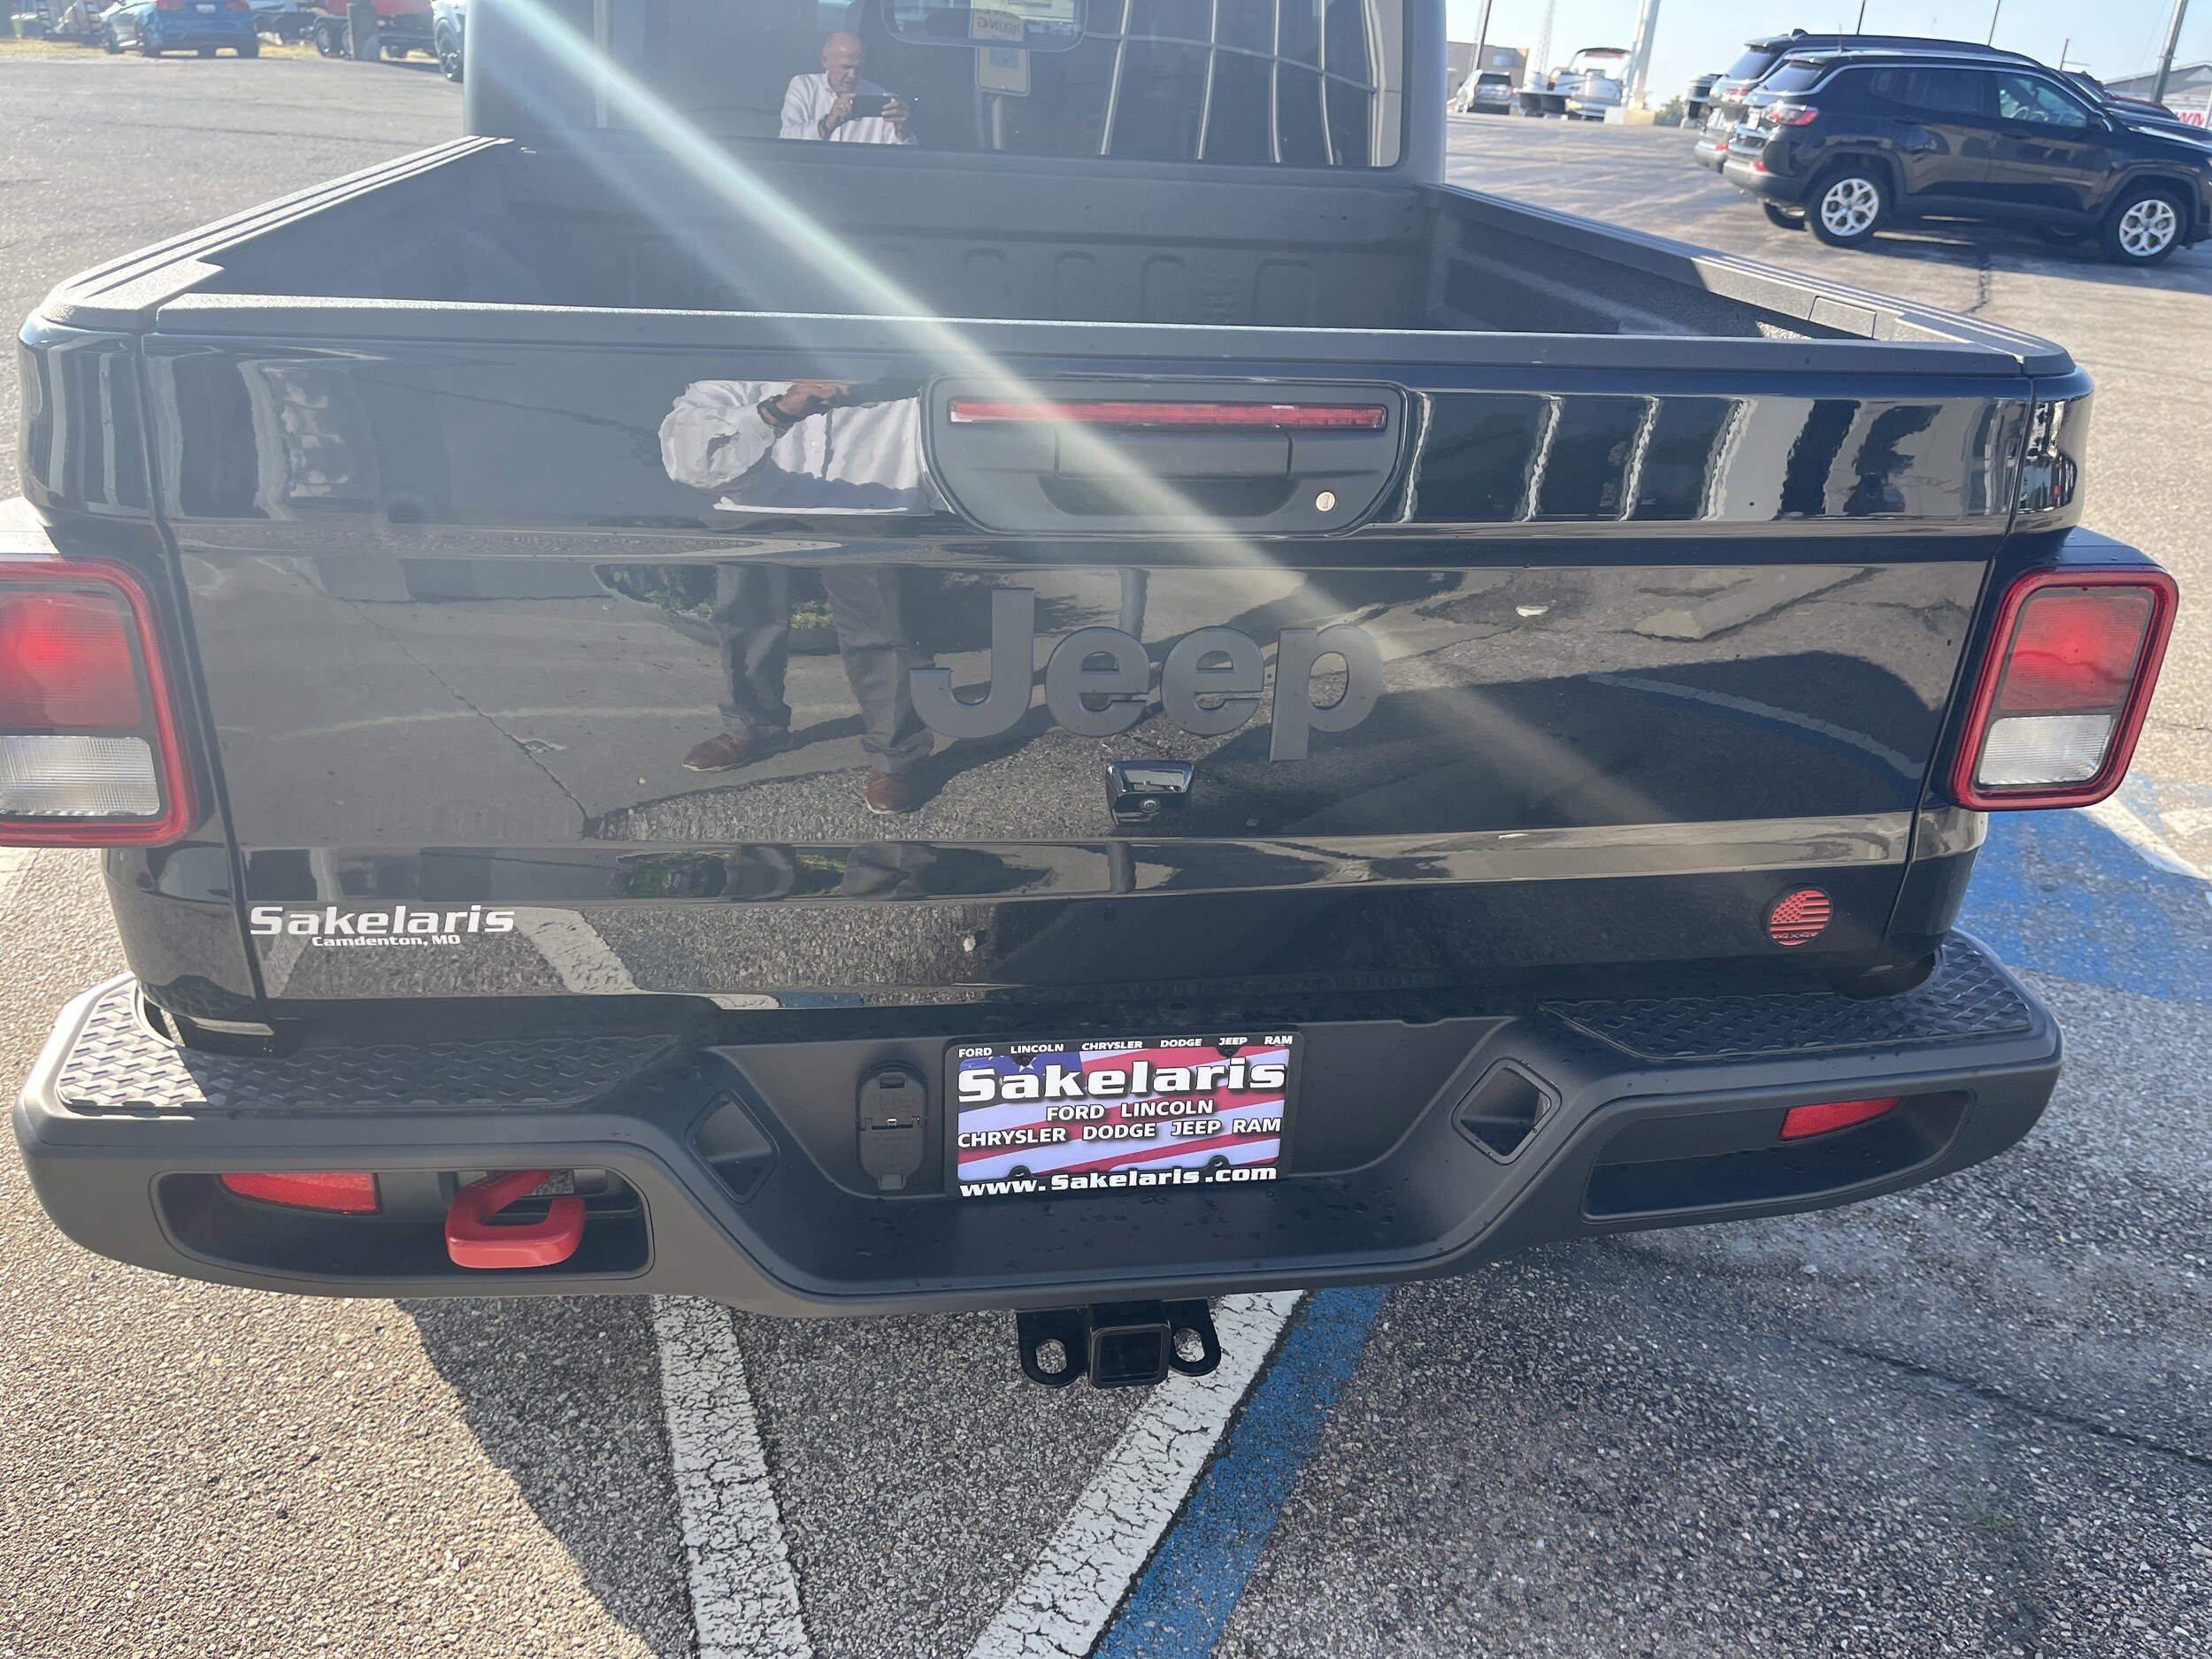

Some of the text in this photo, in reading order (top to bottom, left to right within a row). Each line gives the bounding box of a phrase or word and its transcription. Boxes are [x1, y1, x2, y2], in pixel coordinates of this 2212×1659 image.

[910, 587, 1383, 764] Jeep
[250, 904, 515, 935] Sakelaris
[311, 934, 461, 948] Camdenton, MO
[958, 1035, 1293, 1058] FORD LINCOLN CHRYSLER DODGE JEEP RAM
[958, 1057, 1286, 1103] Sakelaris
[1046, 1099, 1213, 1122] FORD LINCOLN
[957, 1118, 1282, 1148] CHRYSLER DODGE JEEP RAM
